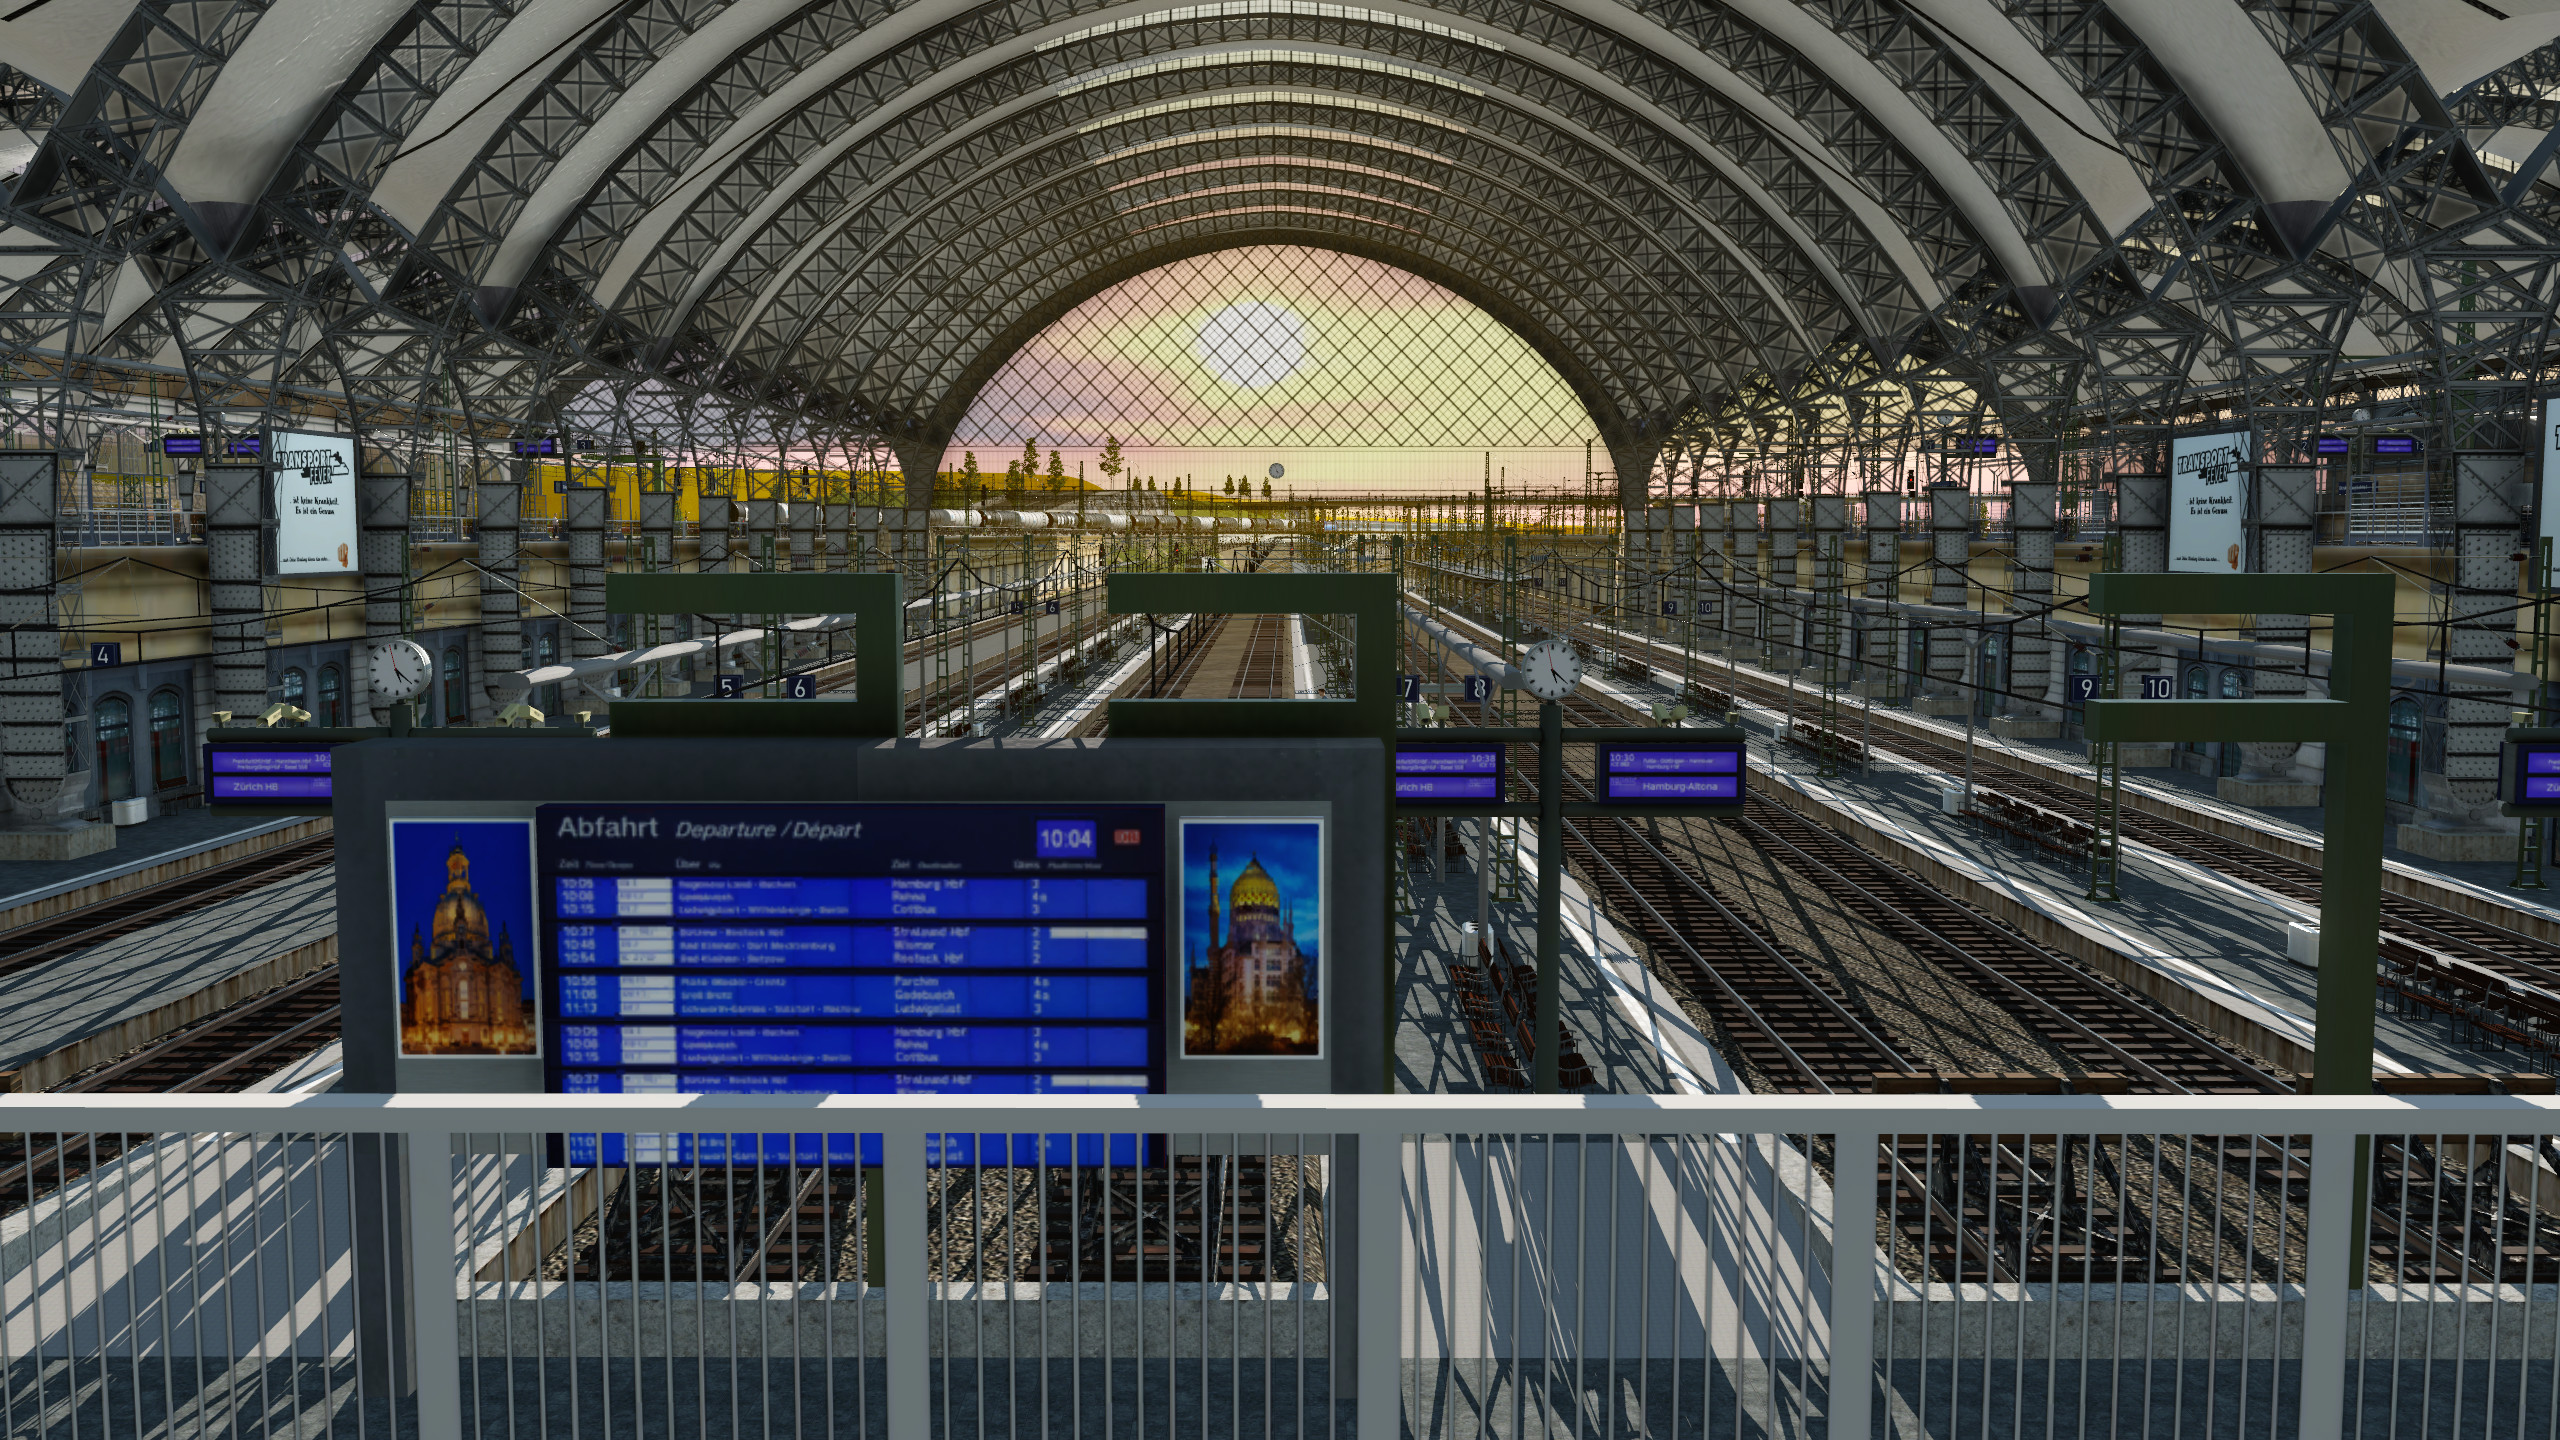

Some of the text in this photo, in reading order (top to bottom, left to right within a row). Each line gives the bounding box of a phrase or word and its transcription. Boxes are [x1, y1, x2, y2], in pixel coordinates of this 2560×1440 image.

[276, 450, 332, 470] TRANSPORT
[2178, 446, 2229, 474] TRANSPORT
[310, 467, 332, 485] FEVER
[2206, 464, 2228, 485] FEVER
[1050, 604, 1055, 612] 6
[1669, 603, 1674, 612] 9
[1701, 603, 1710, 612] 10
[98, 646, 108, 663] 4
[722, 679, 732, 698] 5
[795, 679, 805, 698] 6
[1404, 679, 1412, 697] 7
[1474, 679, 1485, 698] 8
[2081, 679, 2092, 698] 9
[2150, 679, 2170, 698] 10
[1610, 754, 1635, 762] 10:30
[233, 782, 278, 791] Zürich HB
[1396, 782, 1433, 791] ürich HB
[1643, 782, 1718, 793] Hamburg-Altona
[558, 817, 658, 838] Abfahrt
[676, 820, 776, 840] Departure
[1041, 830, 1092, 848] 10:04
[562, 878, 594, 889] 10:05
[892, 879, 940, 891] Hamburg
[563, 904, 595, 914] 10:15
[893, 904, 936, 914] Cottbus
[1032, 905, 1040, 914] 3
[563, 927, 594, 937] 10:37
[950, 927, 970, 937] Hbf
[894, 940, 936, 950] Wismar
[1033, 940, 1040, 950] 2
[564, 953, 596, 963] 10:54
[894, 977, 939, 986] Parchim
[895, 990, 955, 1000] Gadebusch
[895, 1003, 961, 1016] Ludwigslust
[1034, 1004, 1041, 1014] 3
[894, 1027, 943, 1038] Hamburg
[567, 1052, 599, 1062] 10:15
[895, 1052, 938, 1062] Cottbus
